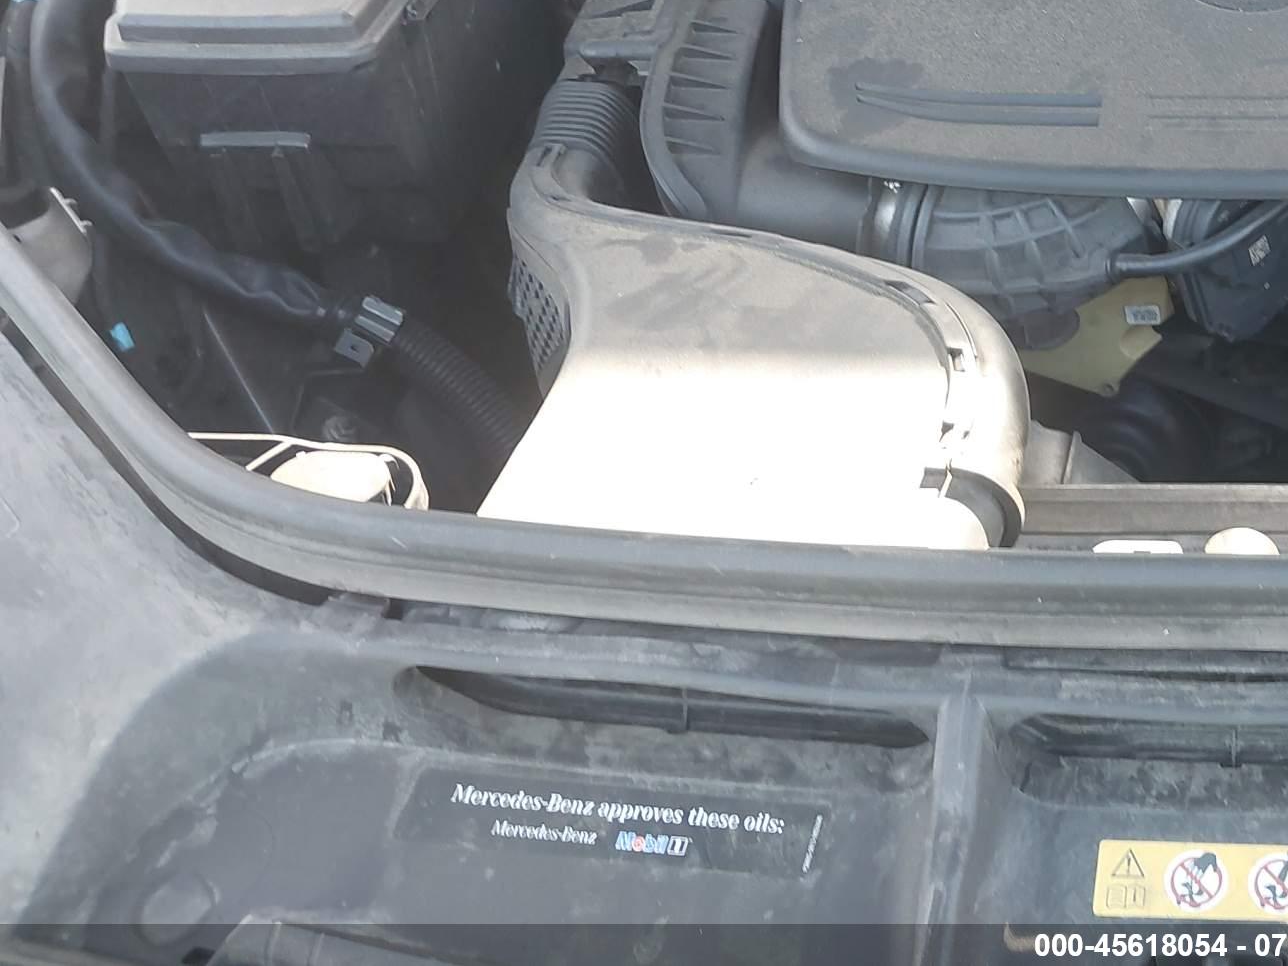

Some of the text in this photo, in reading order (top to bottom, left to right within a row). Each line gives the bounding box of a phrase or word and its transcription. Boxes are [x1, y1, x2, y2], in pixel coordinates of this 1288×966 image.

[451, 783, 785, 834] Mercedes-Benz approves these oils:
[491, 819, 598, 846] Mercedes-Benz
